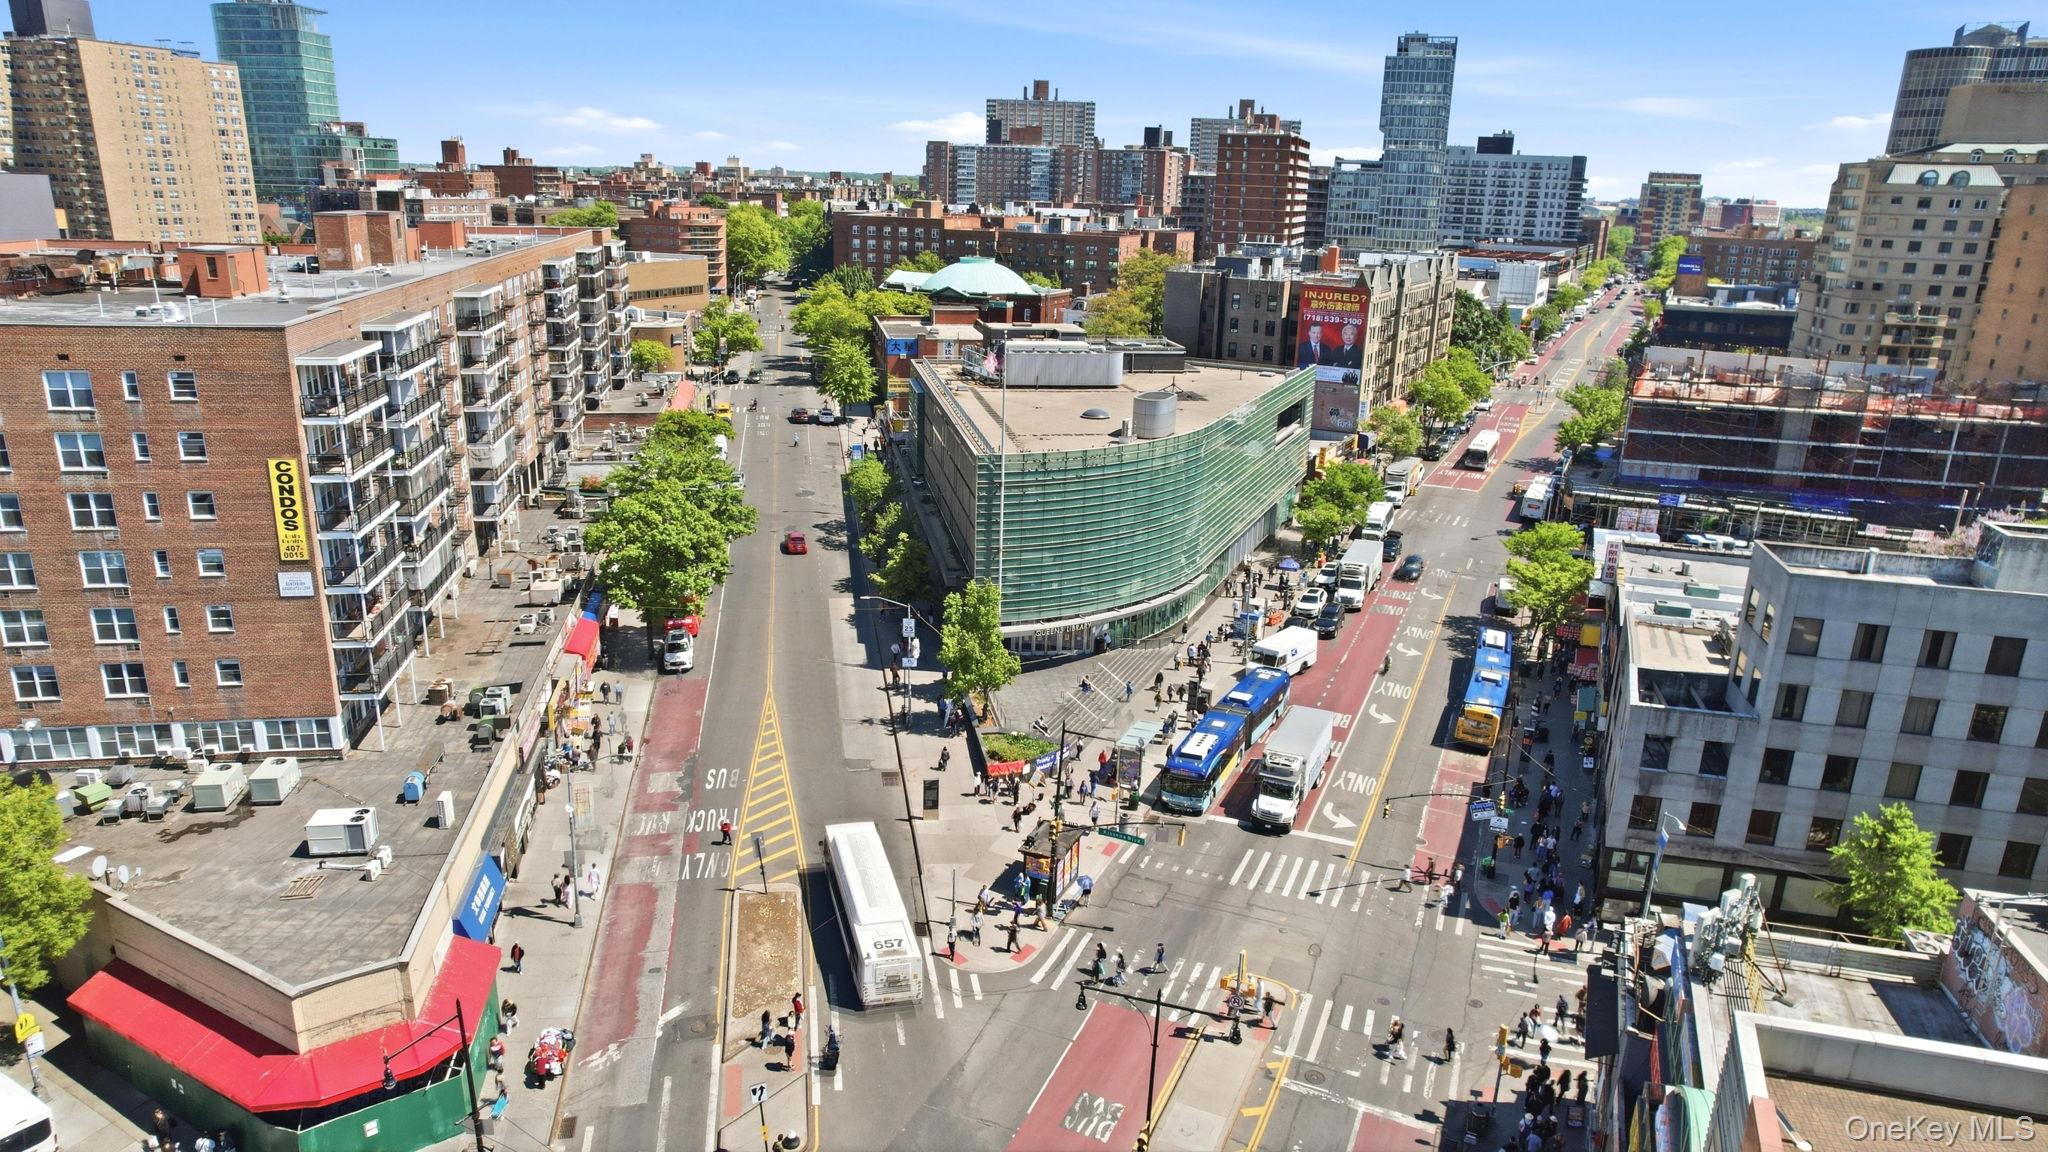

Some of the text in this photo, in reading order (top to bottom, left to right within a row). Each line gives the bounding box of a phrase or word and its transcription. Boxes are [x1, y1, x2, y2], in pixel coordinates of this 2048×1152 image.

[1304, 289, 1367, 303] INJURED?
[274, 460, 300, 532] CONDOS
[283, 551, 305, 559] 0015
[1035, 621, 1092, 637] QUEENS LIBRARY
[1402, 626, 1435, 640] ONLY
[1374, 681, 1412, 700] ONLY
[705, 767, 740, 790] BUS
[1332, 769, 1377, 797] ONLY
[686, 807, 739, 833] TRUCK
[681, 852, 732, 880] ONLY
[873, 938, 903, 950] 657
